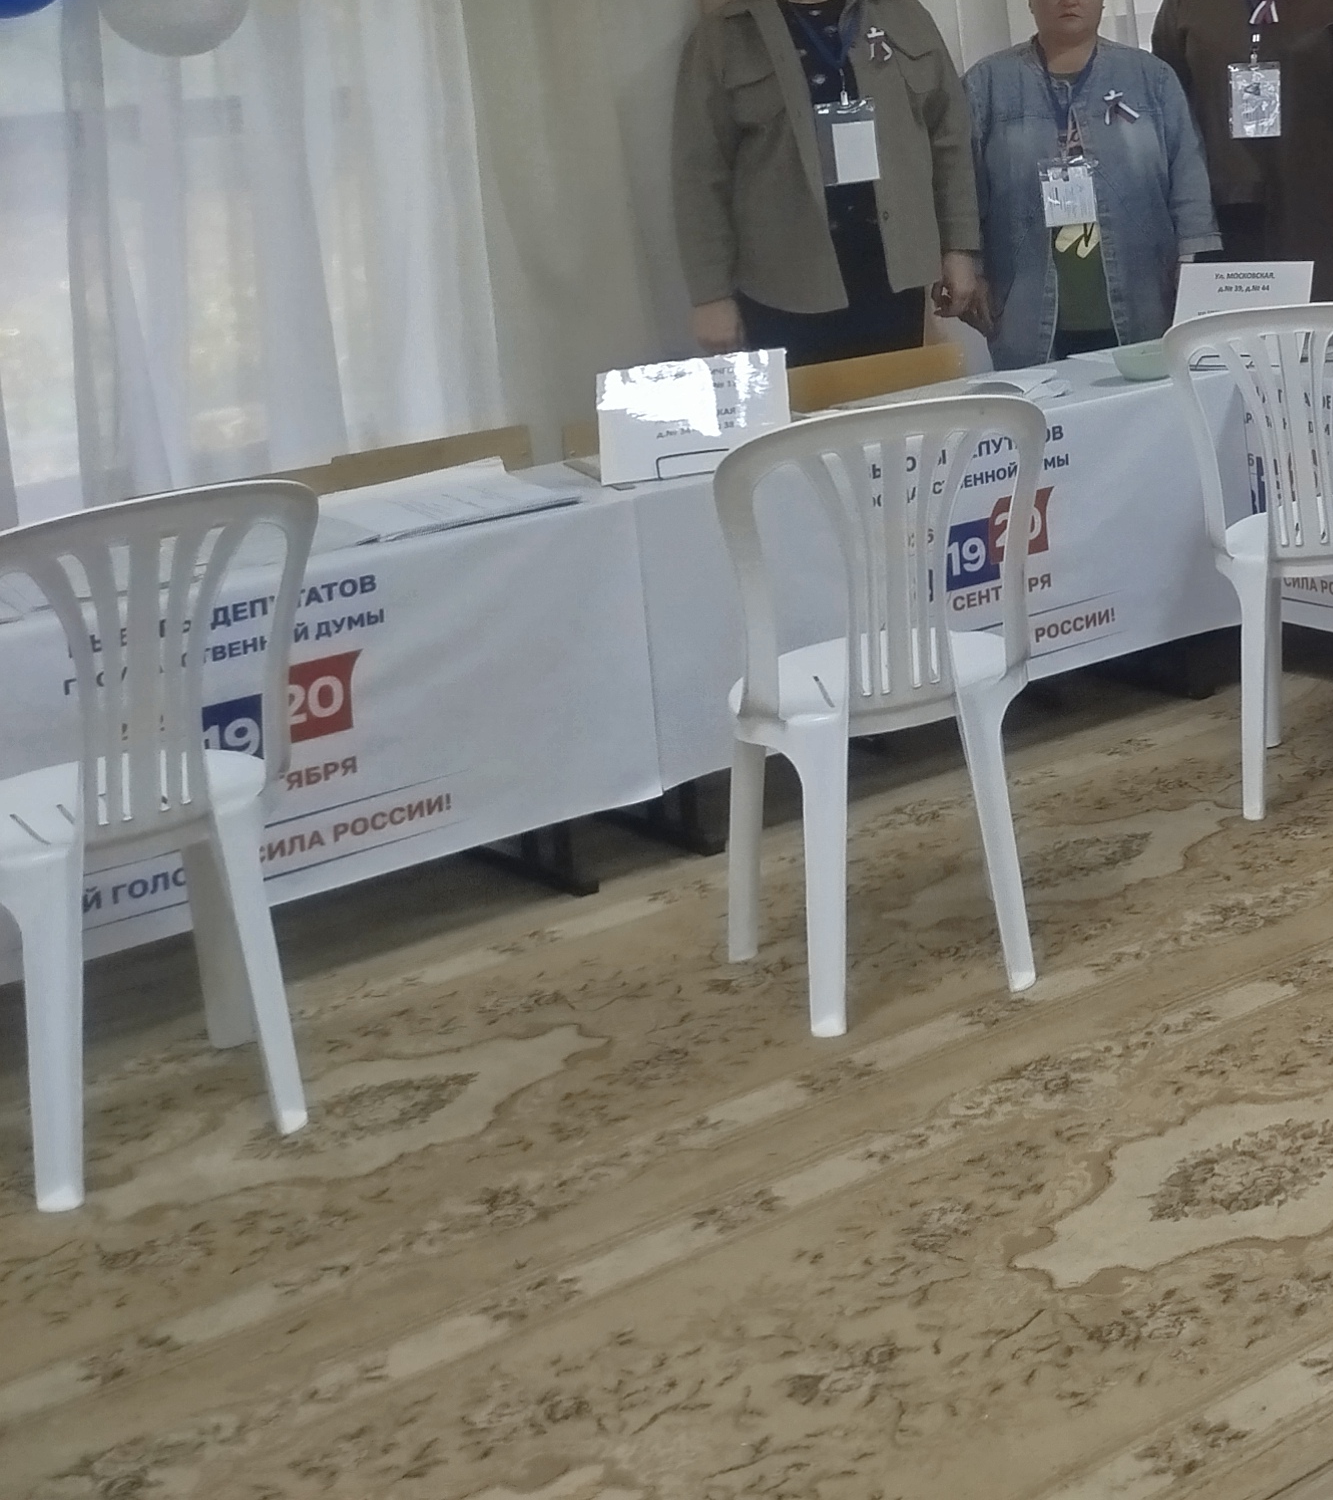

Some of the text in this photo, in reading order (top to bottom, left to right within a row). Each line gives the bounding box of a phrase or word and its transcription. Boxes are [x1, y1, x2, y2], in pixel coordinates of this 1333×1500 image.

[948, 536, 987, 577] 19
[210, 573, 377, 630] ДЕПТАТОВ
[952, 573, 1052, 612] СЕНТРЯ
[315, 608, 386, 641] ДУМЫ
[1034, 607, 1116, 644] РОССИИ!
[332, 793, 452, 843] РОССИИ!
